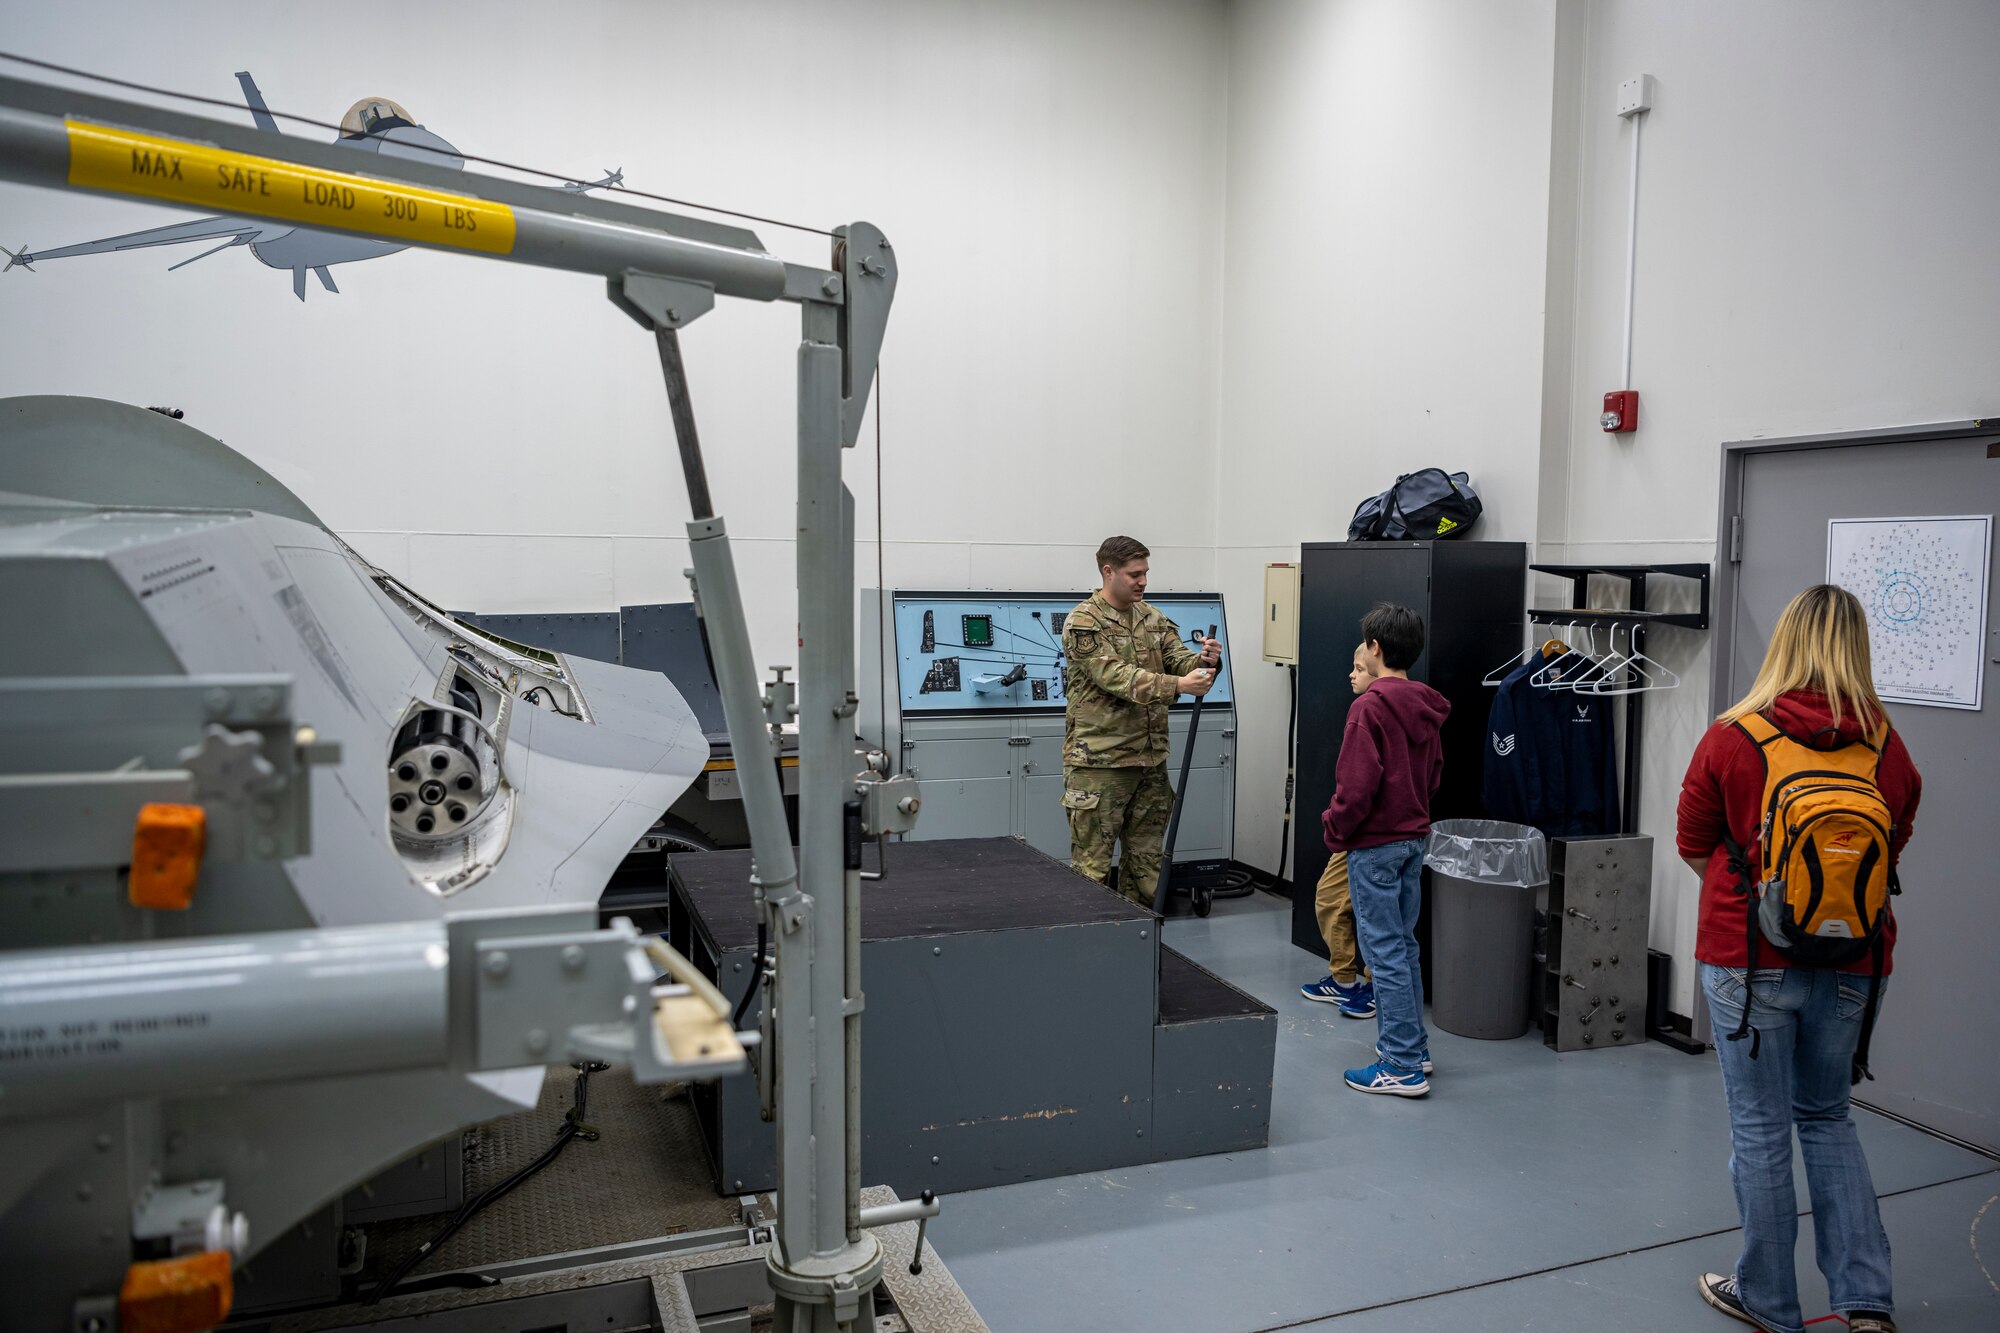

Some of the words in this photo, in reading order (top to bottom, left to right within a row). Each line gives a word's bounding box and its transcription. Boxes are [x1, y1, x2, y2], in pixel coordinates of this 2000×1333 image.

[131, 149, 184, 181] MAX
[218, 164, 272, 197] SAFE
[303, 180, 355, 211] LOAD
[384, 194, 418, 222] 300
[443, 207, 477, 232] LBS
[1436, 521, 1458, 535] adidas
